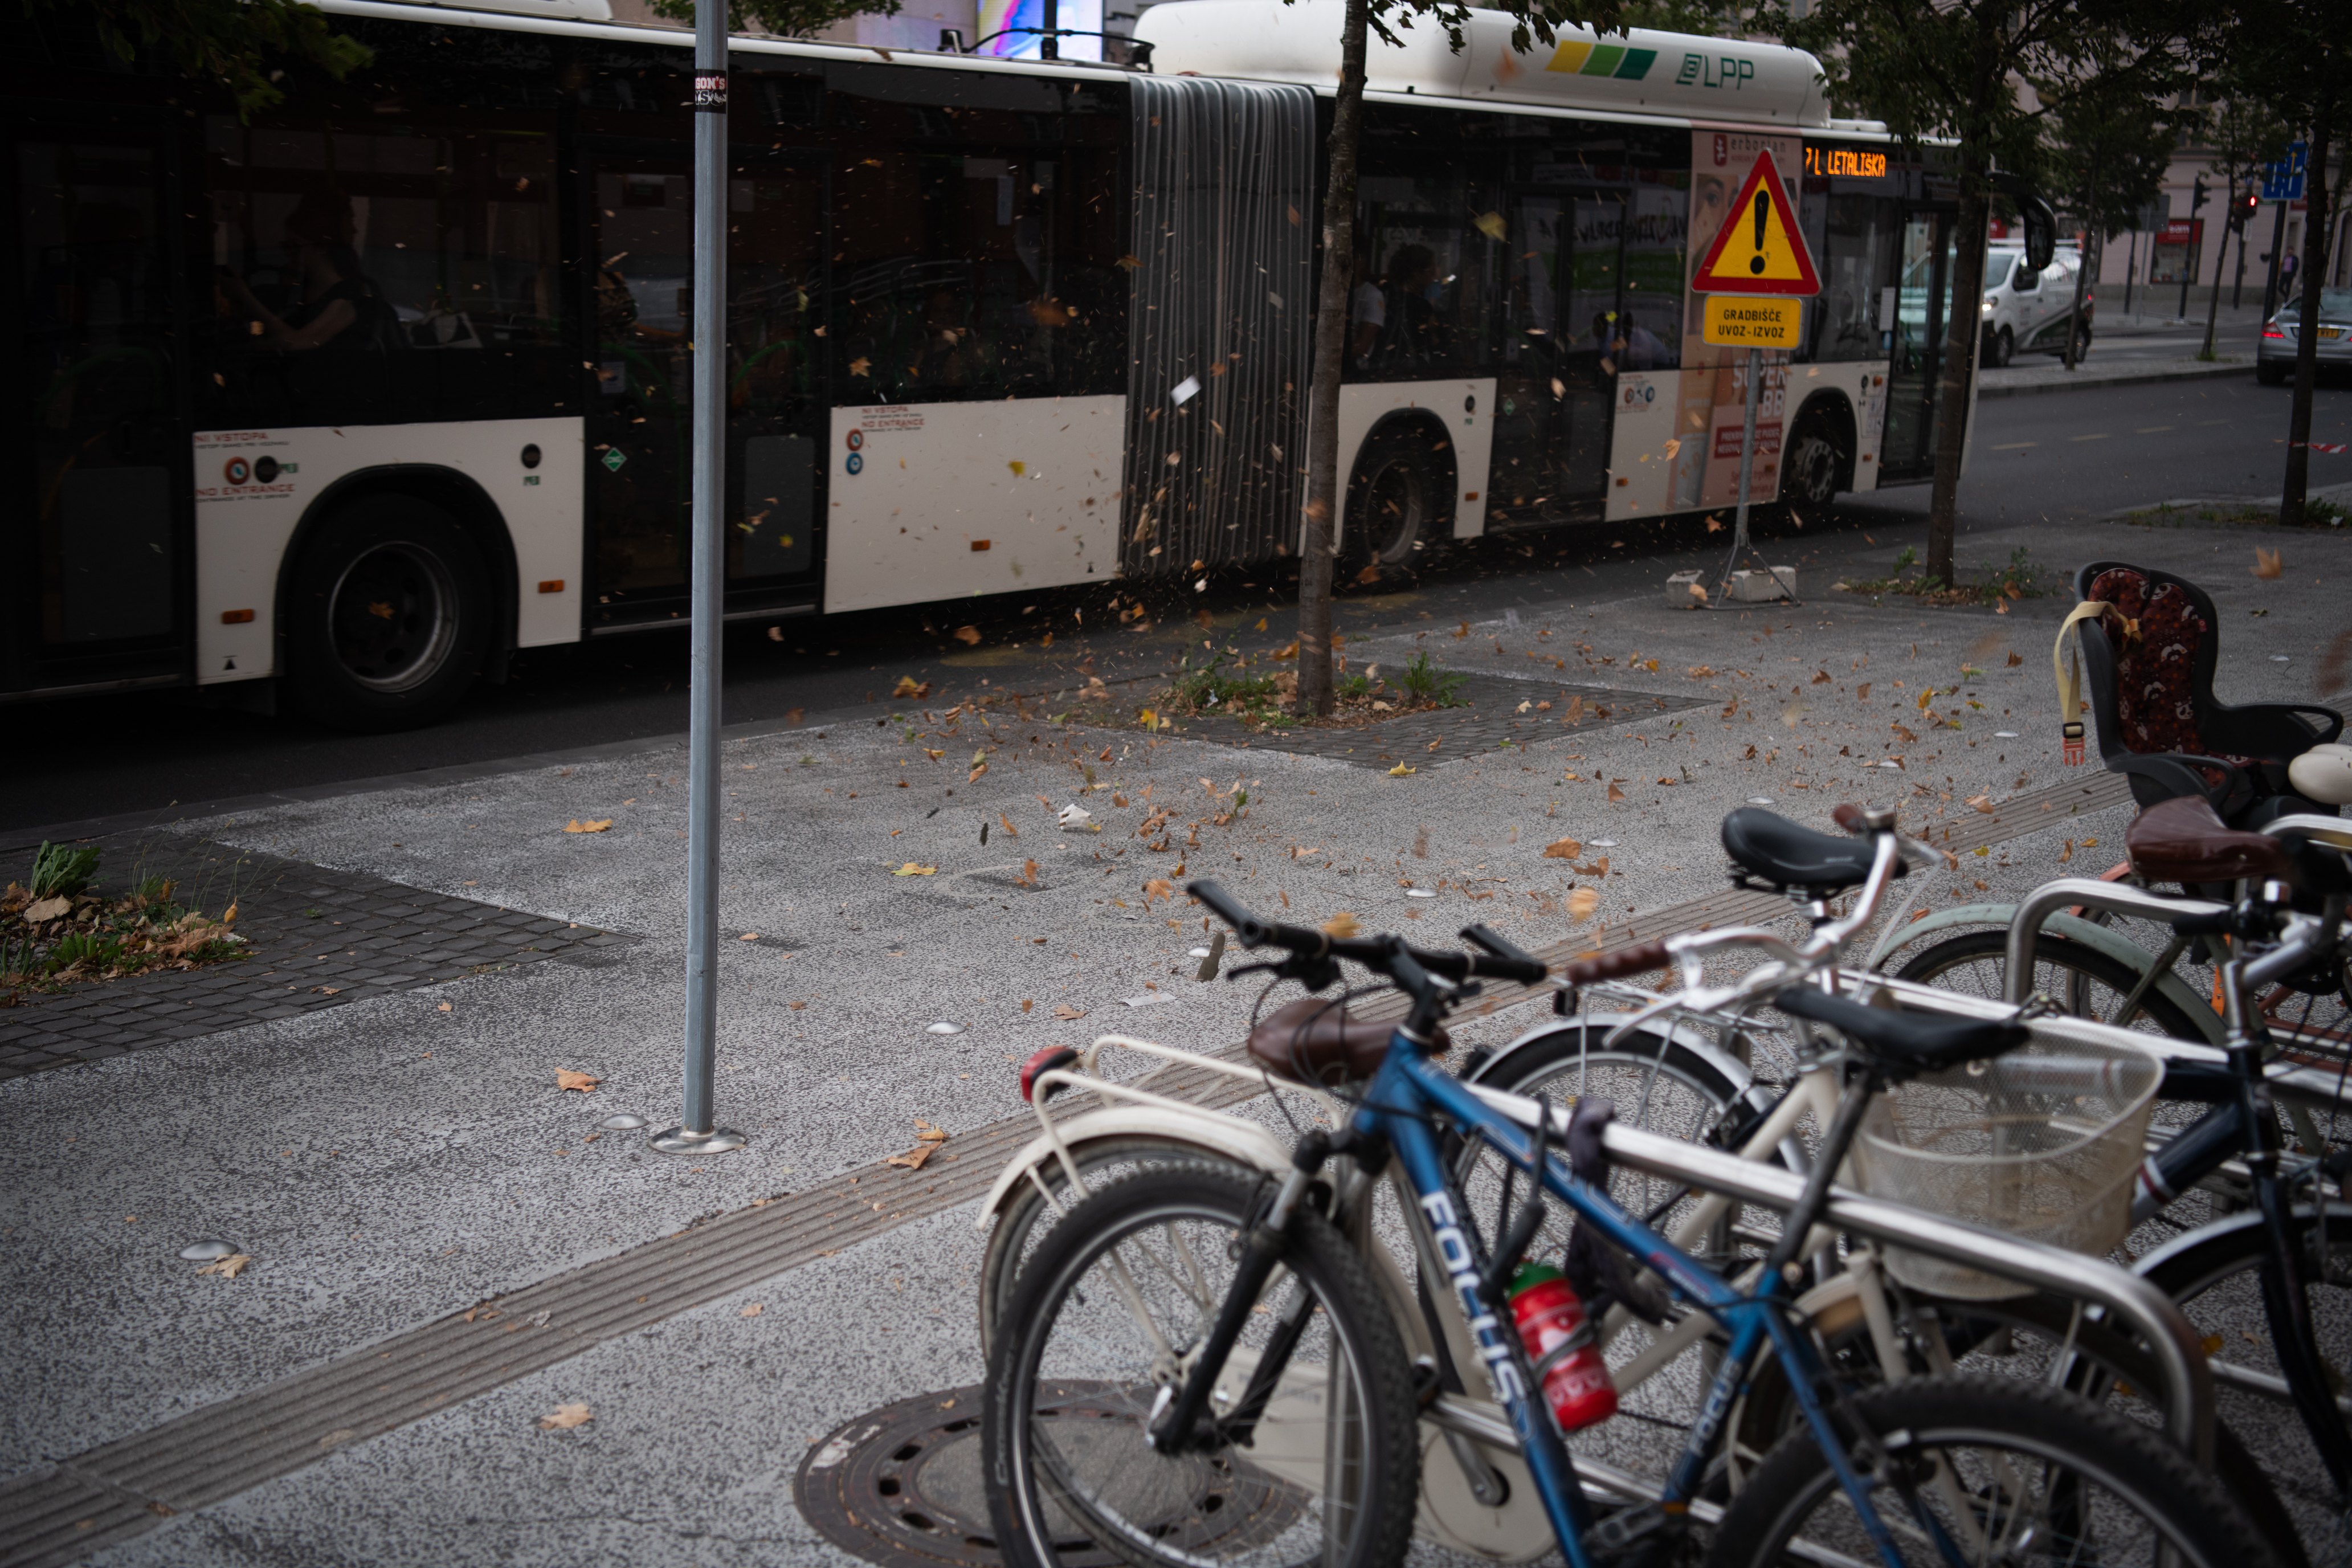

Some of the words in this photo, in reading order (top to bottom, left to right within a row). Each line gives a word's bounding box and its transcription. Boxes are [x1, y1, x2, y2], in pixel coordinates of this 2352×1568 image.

[695, 76, 725, 89] GON'S
[1731, 134, 1791, 153] erborian
[1827, 150, 1886, 177] LETALIŠKA
[1724, 308, 1782, 322] GRADBIŠČE
[1762, 389, 1785, 418] BB
[878, 418, 924, 427] ENTRANCE
[214, 432, 268, 442] VSTOPA
[222, 483, 295, 495] ENTRANCE
[1420, 1190, 1526, 1405] FOCUS
[1688, 1355, 1743, 1458] FOCUS
